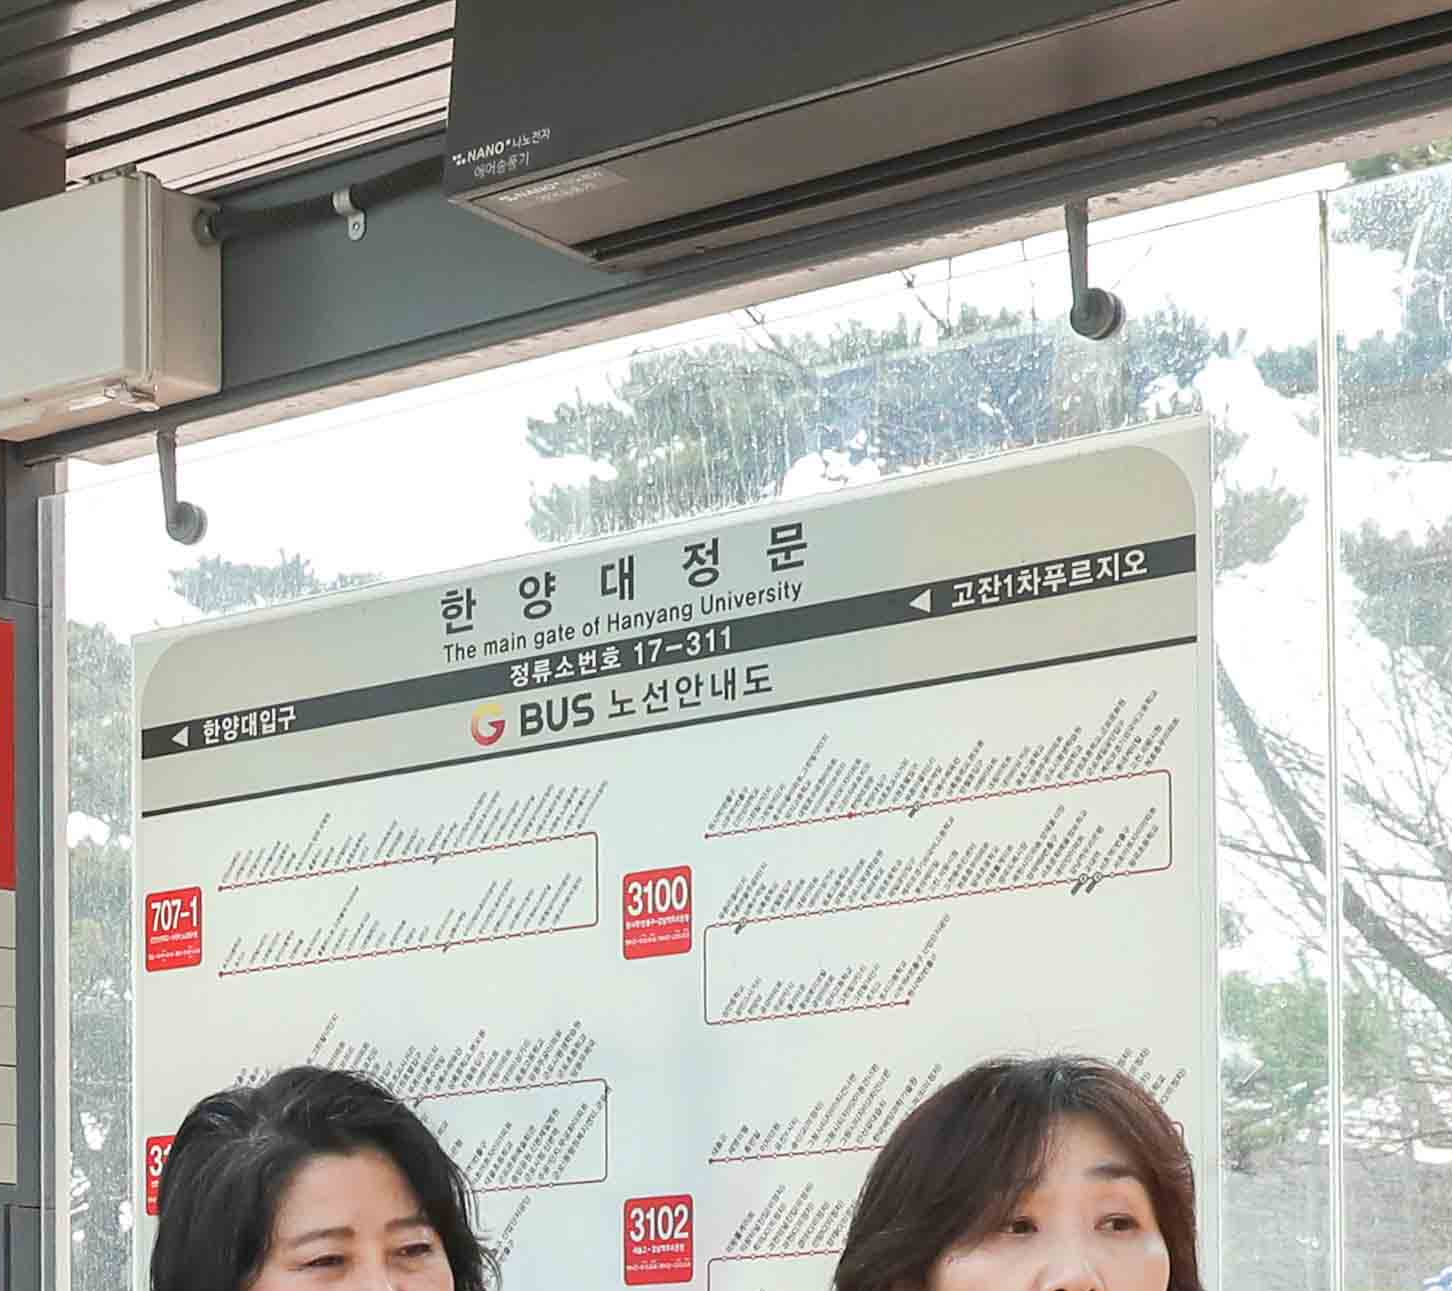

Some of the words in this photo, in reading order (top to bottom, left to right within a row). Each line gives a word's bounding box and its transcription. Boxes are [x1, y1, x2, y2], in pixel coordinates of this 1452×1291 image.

[951, 549, 1149, 608] 고잔1차푸르지오
[444, 643, 477, 664] The
[483, 633, 528, 656] main
[533, 623, 576, 652] gate
[582, 617, 601, 638] of
[607, 603, 694, 633] Hanyang
[700, 581, 804, 616] University
[508, 645, 623, 688] 정류소번호
[633, 625, 733, 667] 17-311
[202, 704, 297, 745] 한양대입구
[519, 692, 596, 737] BUS
[607, 664, 774, 720] 노선안내도
[151, 895, 199, 932] 707-1
[627, 874, 691, 917] 3100
[629, 1203, 690, 1243] 3102
